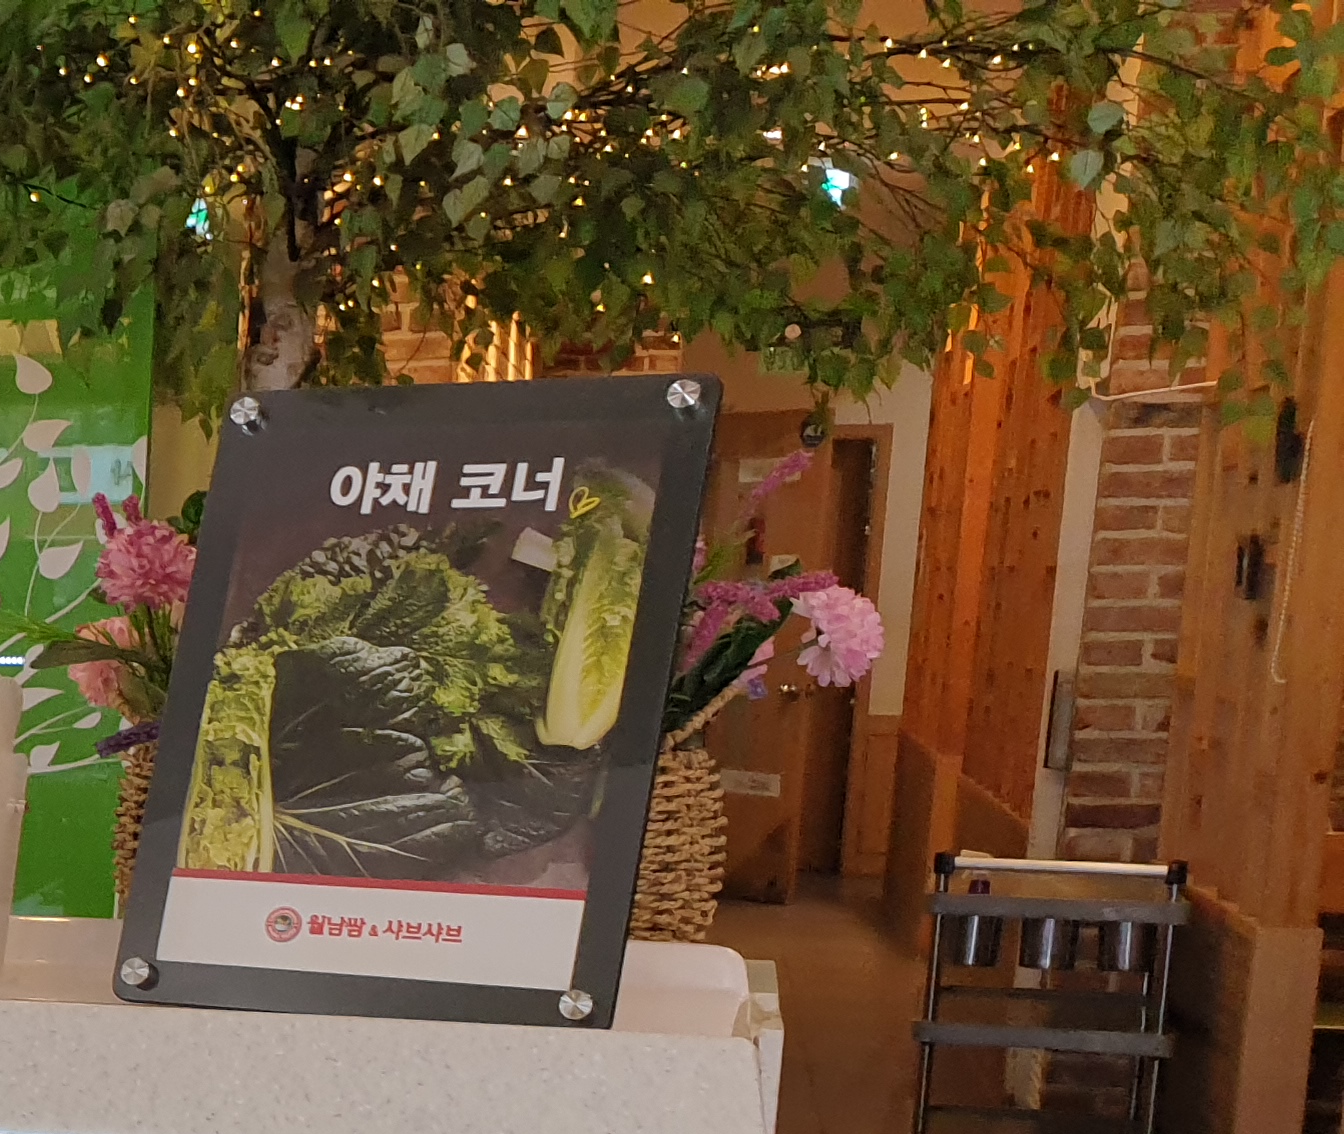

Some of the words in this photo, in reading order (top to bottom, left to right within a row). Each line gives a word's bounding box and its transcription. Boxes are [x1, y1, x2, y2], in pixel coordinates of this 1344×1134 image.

[329, 460, 438, 515] 야채
[450, 456, 566, 512] 코너
[306, 913, 367, 939] 월남쌈
[382, 918, 463, 944] 샤브샤브
